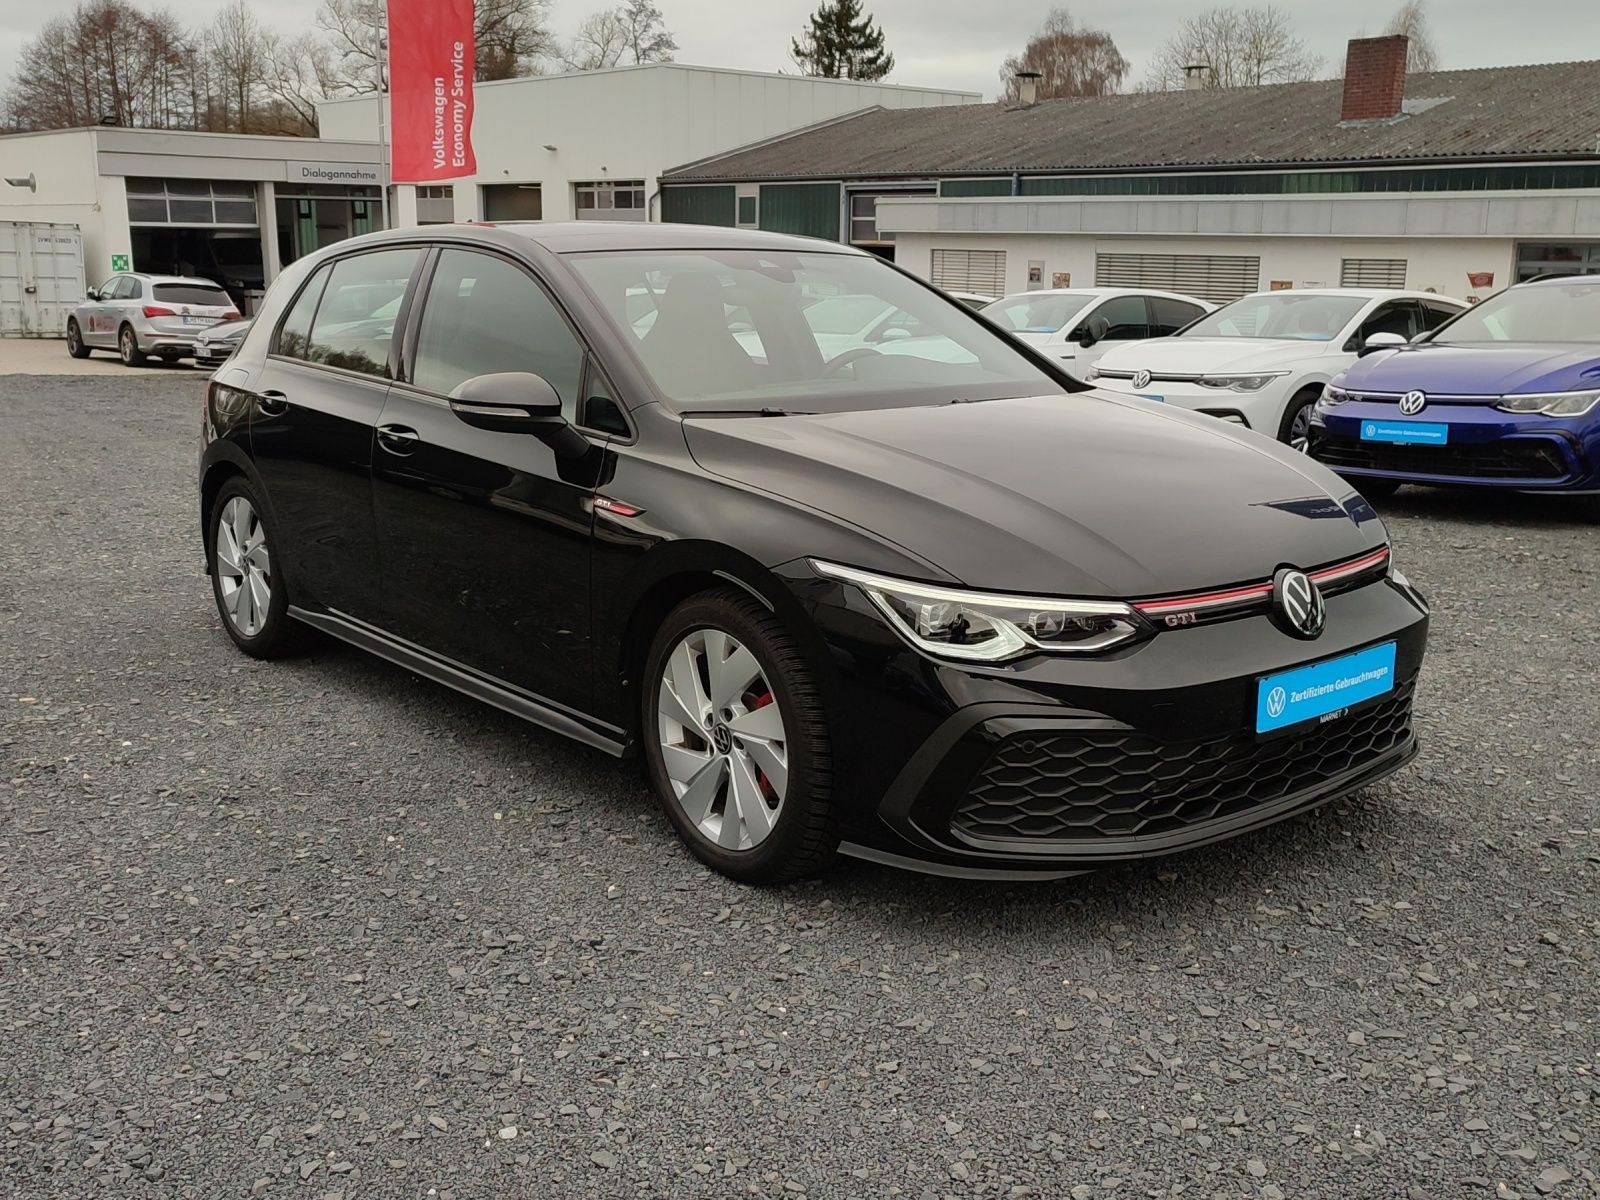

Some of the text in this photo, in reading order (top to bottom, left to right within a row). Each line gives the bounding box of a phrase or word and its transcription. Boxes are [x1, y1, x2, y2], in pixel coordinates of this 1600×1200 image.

[450, 41, 467, 167] Economy Service
[432, 77, 447, 169] Volkswagen
[302, 167, 376, 180] Dialogannahme
[596, 498, 611, 508] GTI
[1164, 611, 1197, 627] GTI
[1290, 666, 1389, 703] Zertifizierte Gebrauchtwagen
[1320, 709, 1342, 724] MARNET
